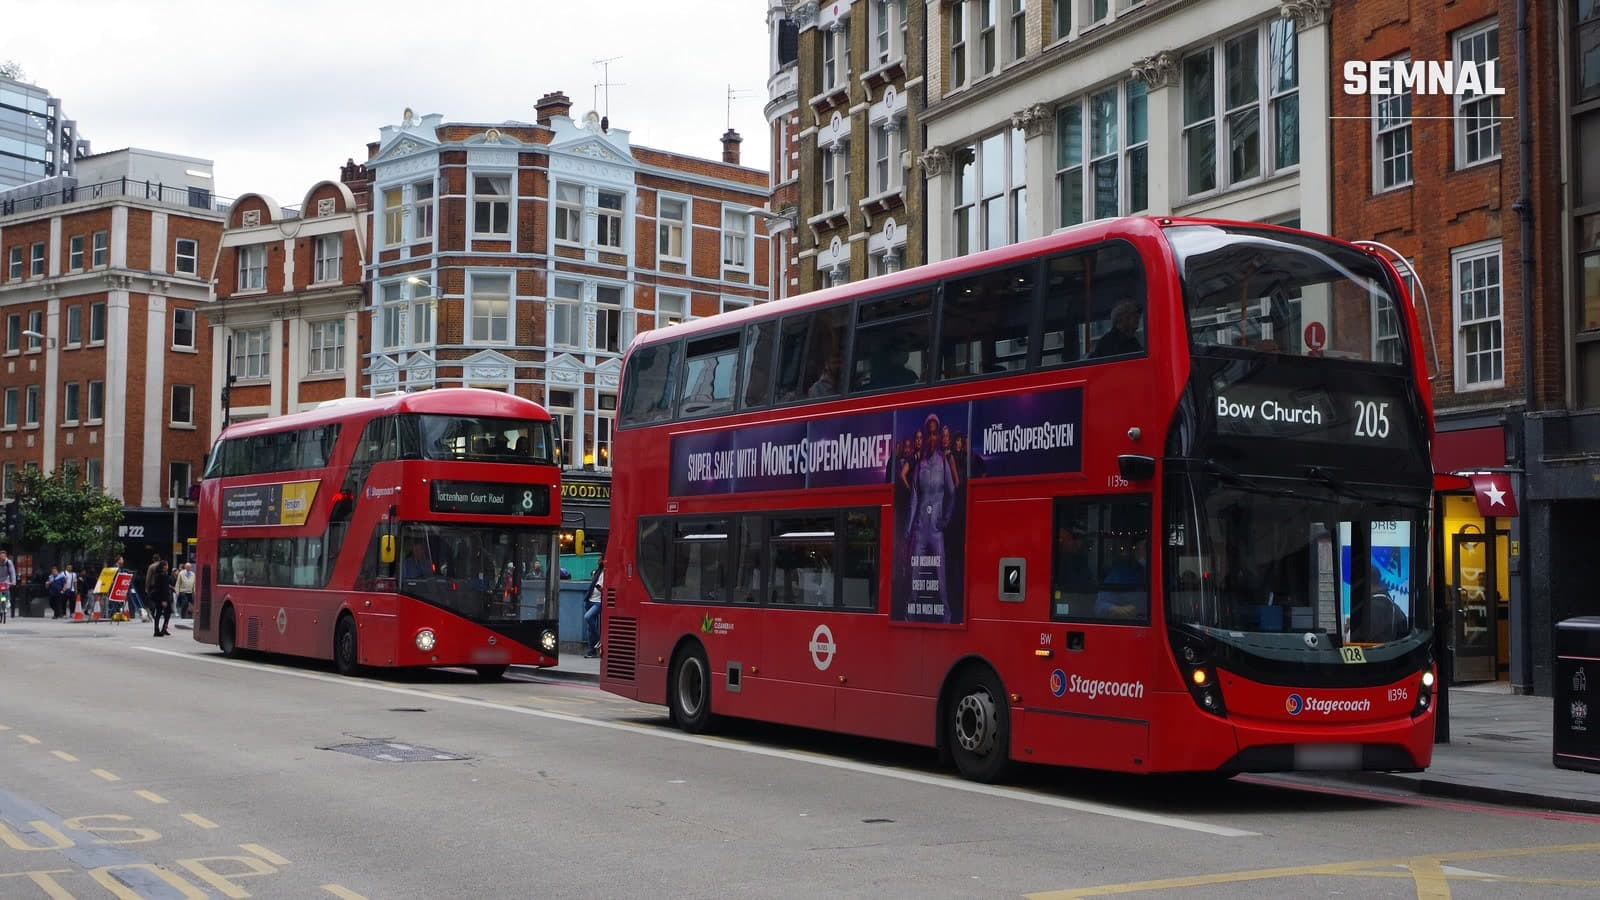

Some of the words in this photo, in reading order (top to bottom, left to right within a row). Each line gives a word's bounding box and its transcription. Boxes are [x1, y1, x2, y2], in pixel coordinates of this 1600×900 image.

[1311, 326, 1320, 347] L
[1217, 396, 1255, 418] Bow
[1261, 401, 1321, 424] Church
[1354, 401, 1390, 438] 205
[688, 453, 712, 482] SUPER
[714, 450, 734, 480] SAVE
[737, 447, 757, 478] WITH
[1107, 474, 1129, 488] 11396
[470, 492, 487, 503] Court
[488, 493, 505, 504] Road
[522, 490, 533, 509] 8
[129, 525, 145, 538] 222
[1040, 633, 1052, 645] BW
[1343, 648, 1361, 661] 128
[1069, 674, 1144, 700] Stagecoach
[1387, 688, 1408, 702] 11396
[1304, 697, 1371, 715] Stagecoach
